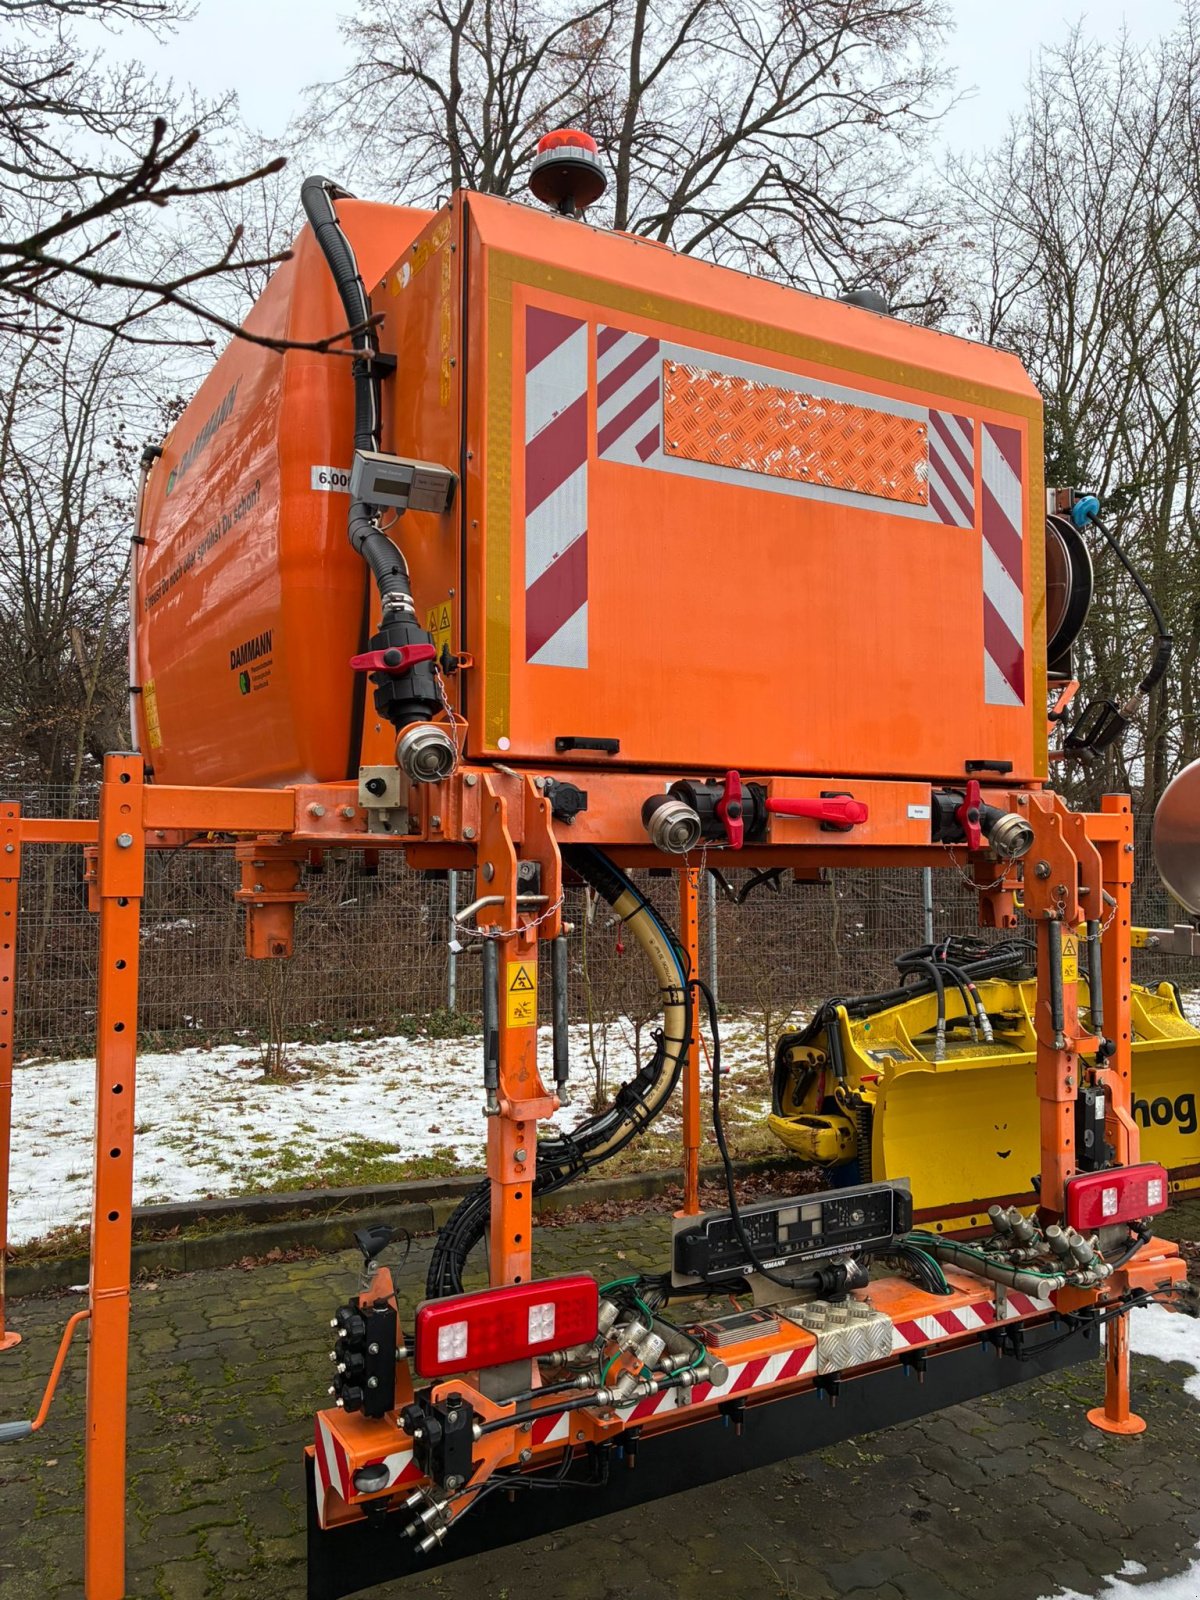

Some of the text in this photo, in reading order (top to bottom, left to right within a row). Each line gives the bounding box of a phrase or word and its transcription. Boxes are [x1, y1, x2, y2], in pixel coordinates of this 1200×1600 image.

[222, 514, 232, 536] Du
[234, 479, 261, 522] schon?
[230, 629, 272, 671] DAMMANN
[801, 1244, 862, 1262] www.dammann-technik.de
